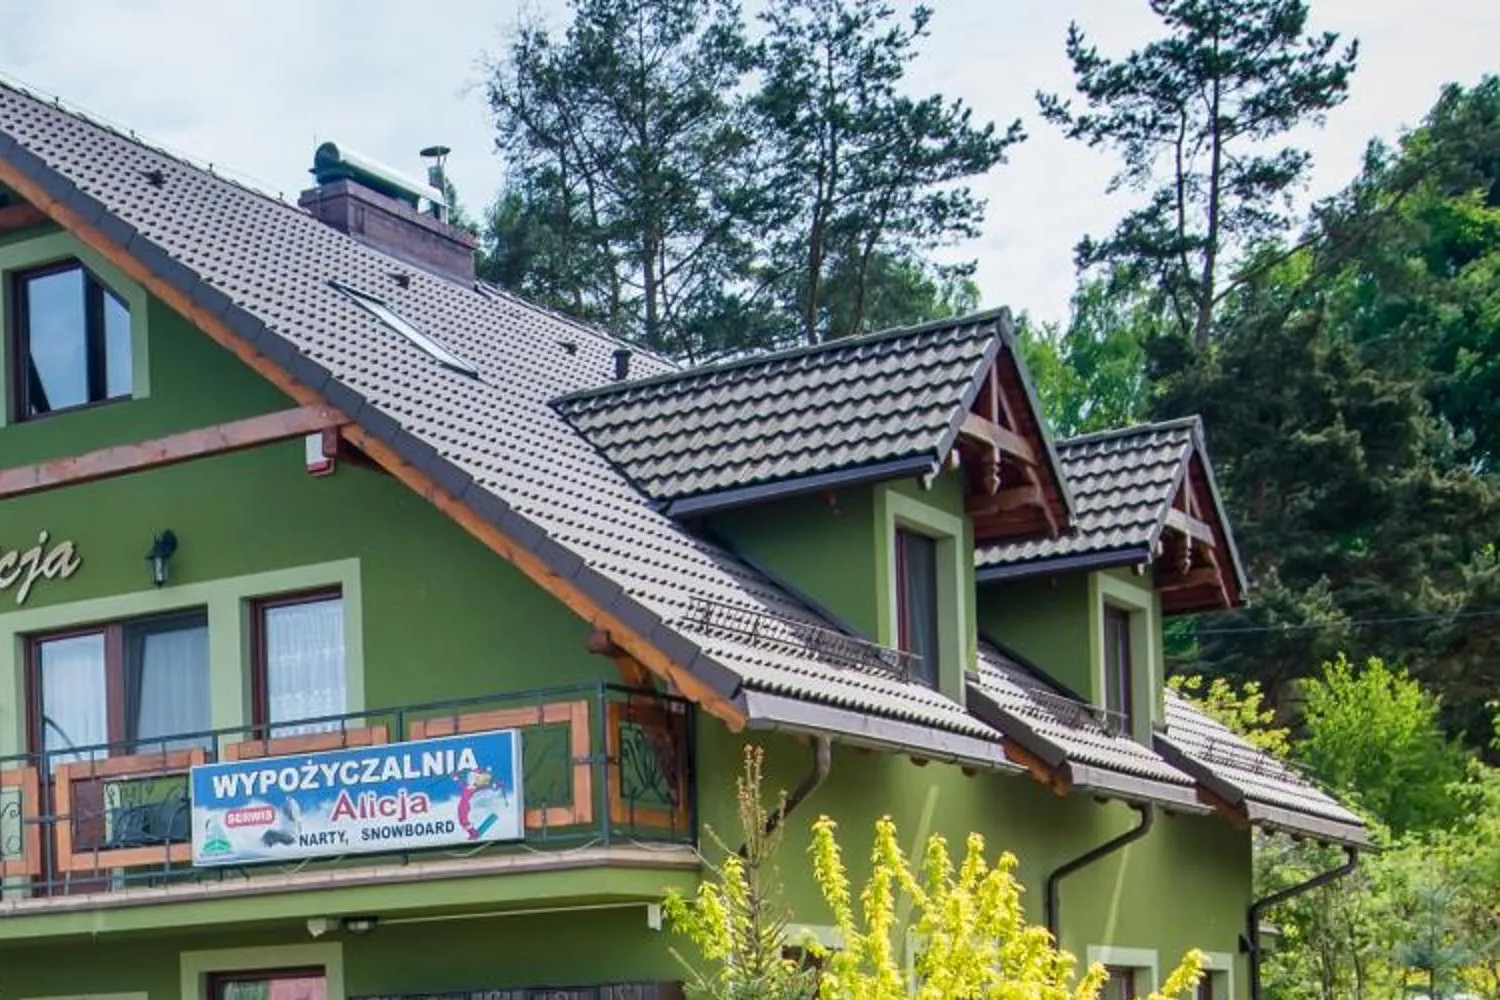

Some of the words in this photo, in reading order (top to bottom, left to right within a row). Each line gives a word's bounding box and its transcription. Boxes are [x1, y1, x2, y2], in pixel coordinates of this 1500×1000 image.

[213, 747, 478, 799] WYPOŻYCZALNIA
[329, 788, 431, 823] Alicja
[299, 830, 349, 847] NARTY,
[361, 821, 455, 841] SNOWBOARD
